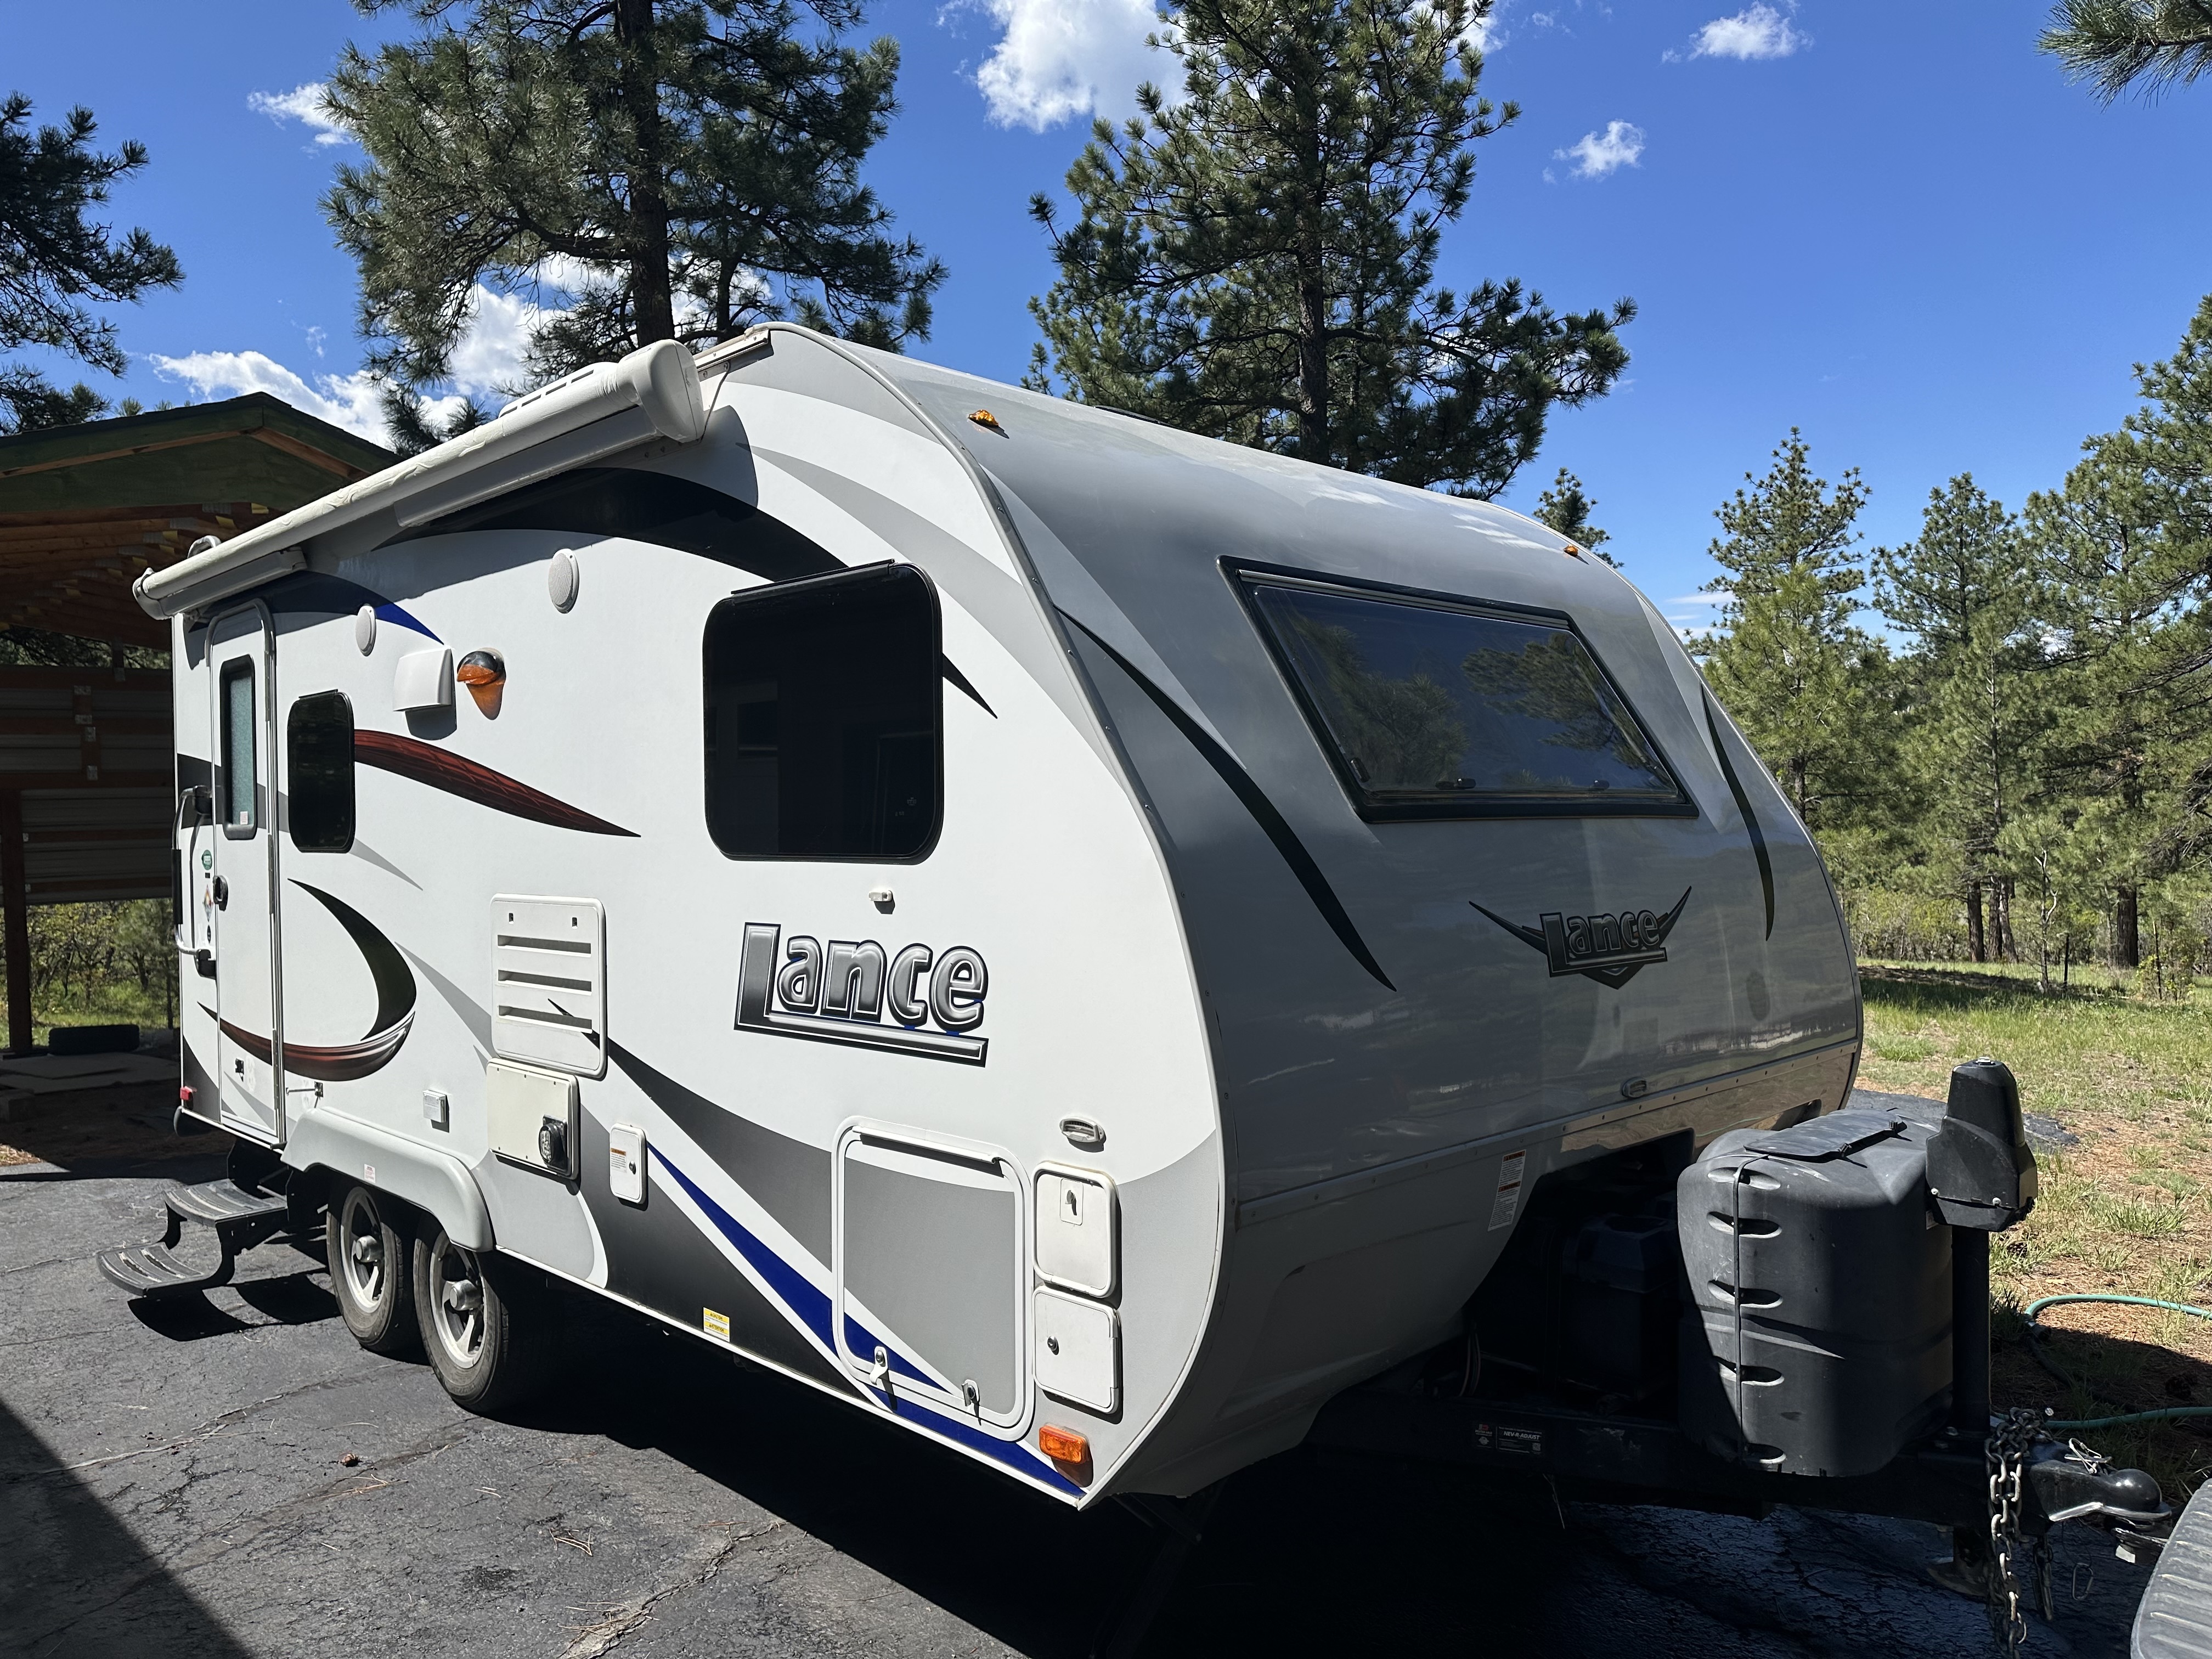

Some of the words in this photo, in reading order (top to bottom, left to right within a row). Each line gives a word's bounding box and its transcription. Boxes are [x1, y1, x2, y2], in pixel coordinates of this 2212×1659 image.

[1539, 910, 1668, 978] Lance
[733, 922, 989, 1068] Lance
[1503, 1431, 1540, 1440] NEV-R-ADJUST
